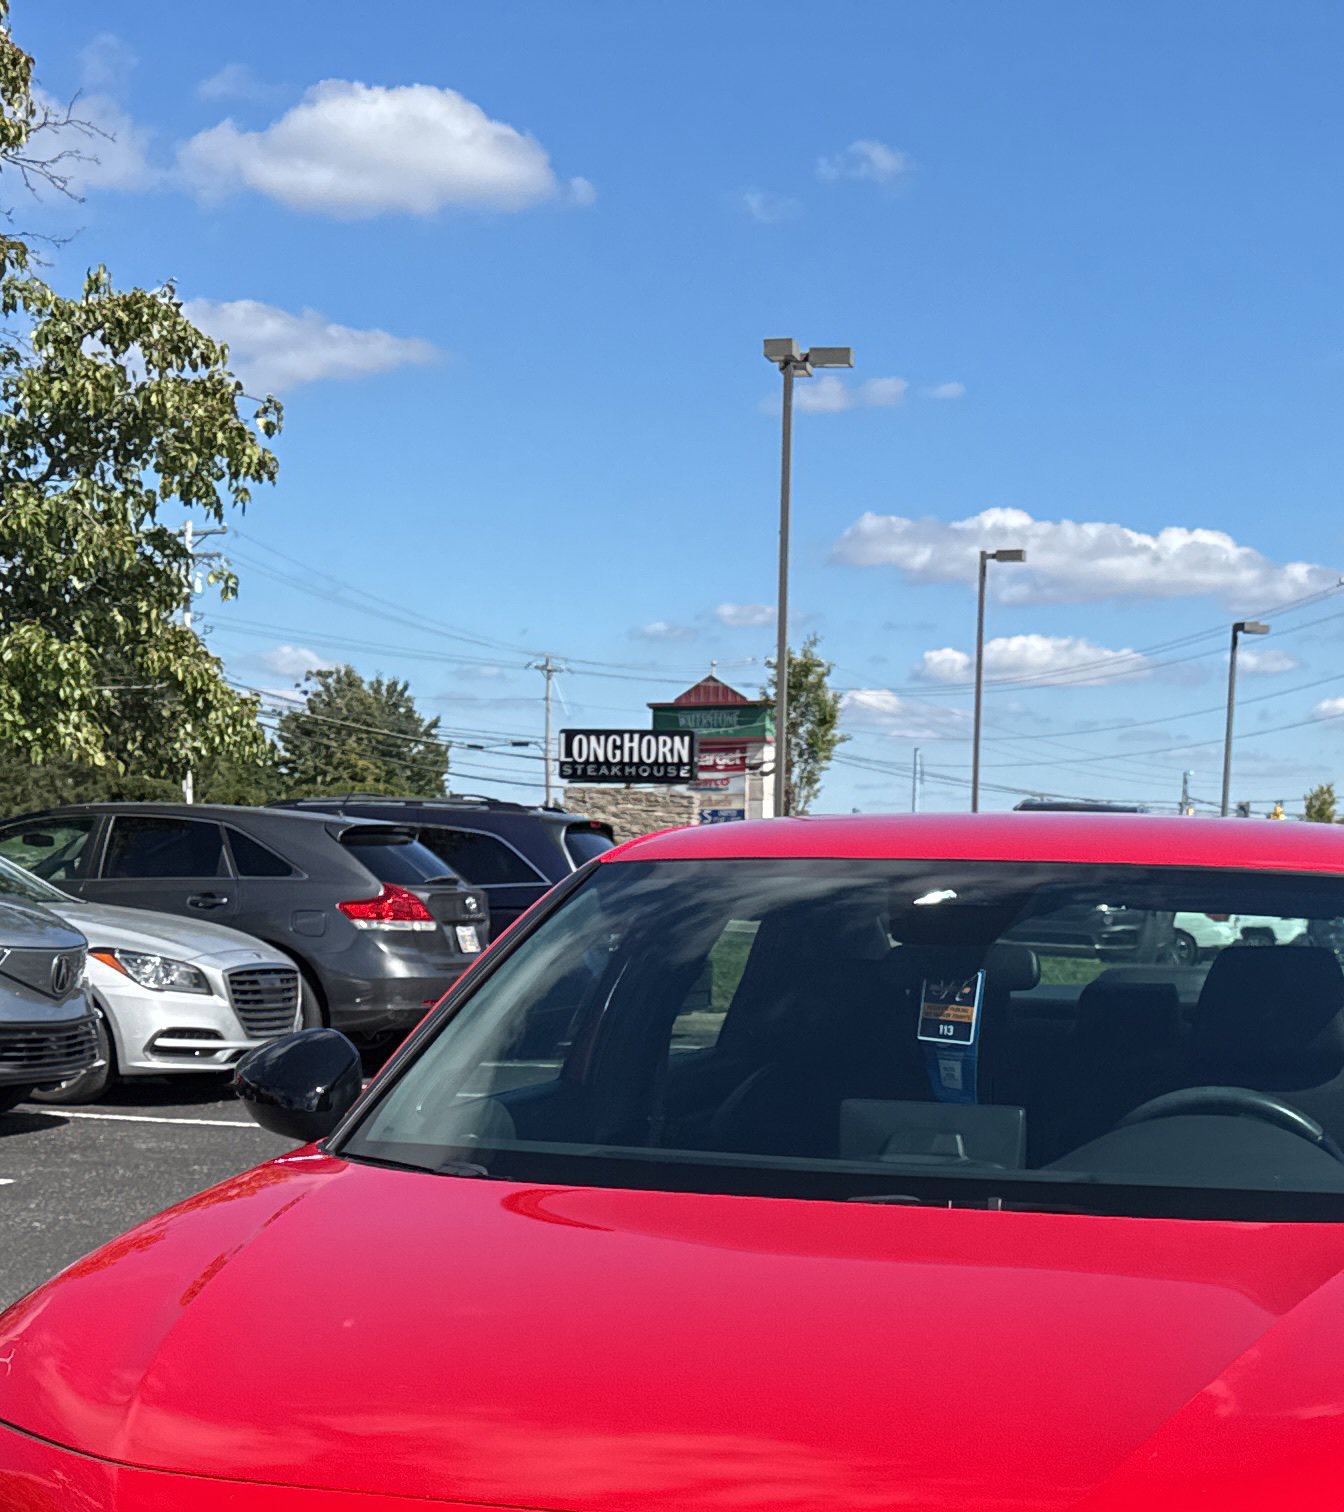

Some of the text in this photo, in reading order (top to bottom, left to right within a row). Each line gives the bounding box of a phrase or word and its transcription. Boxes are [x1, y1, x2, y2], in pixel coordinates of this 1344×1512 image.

[560, 732, 690, 763] LONGHORN
[562, 764, 691, 777] STEAKHOUSE
[939, 1024, 954, 1036] 113
